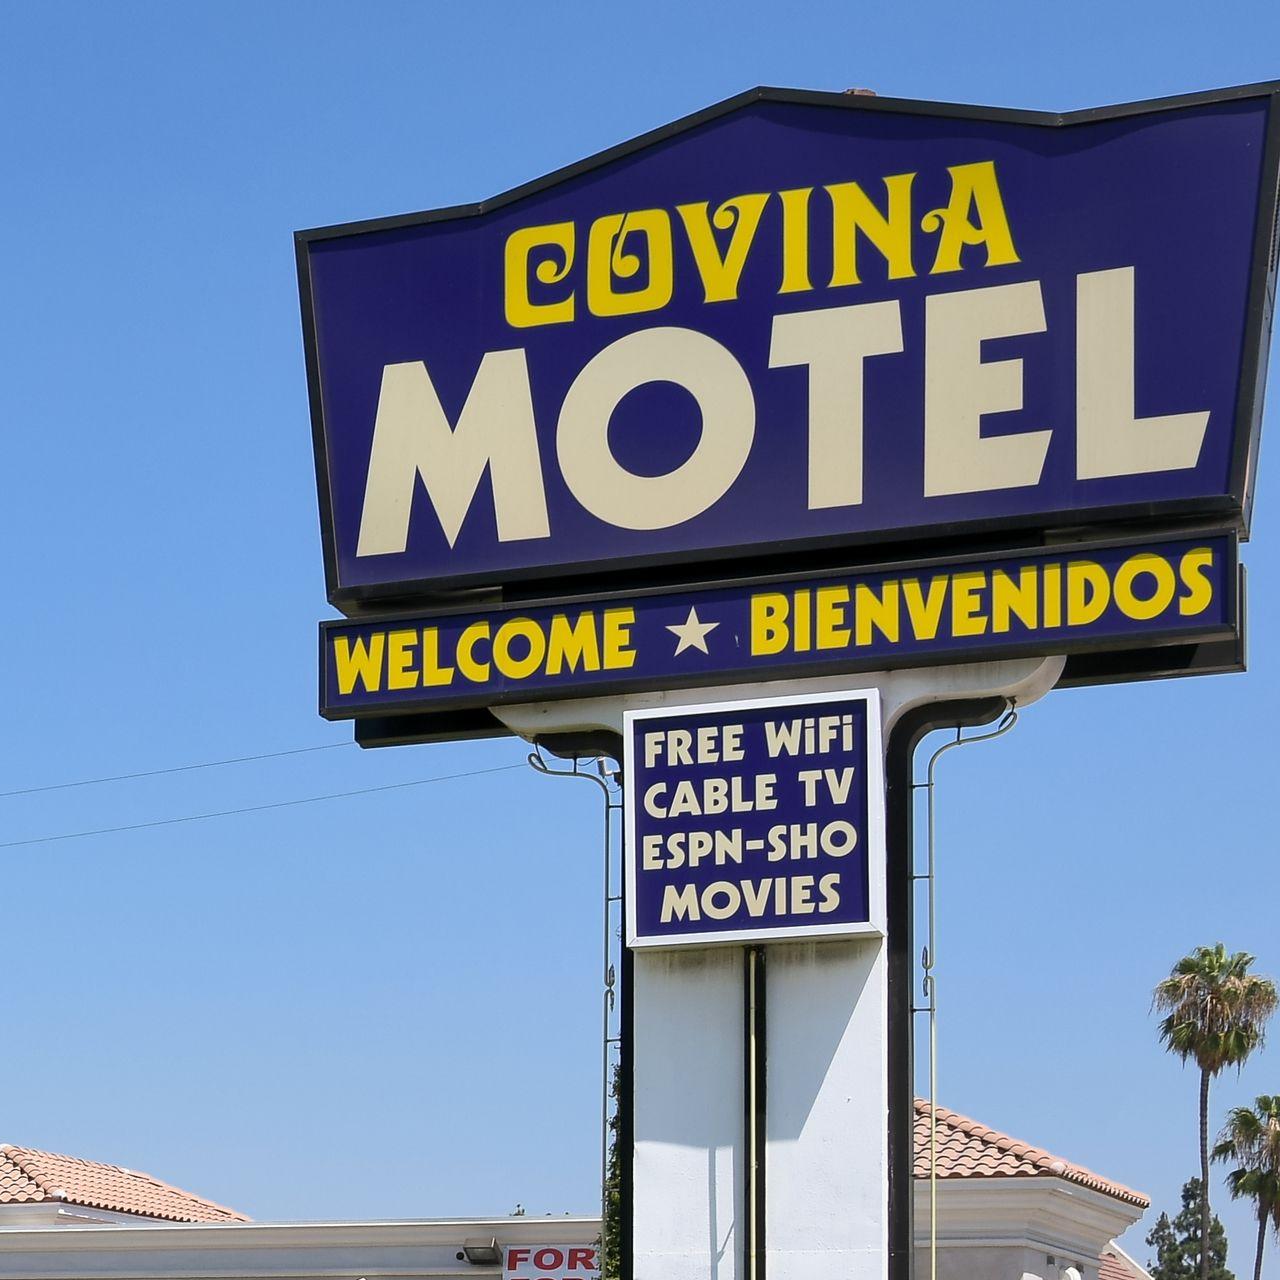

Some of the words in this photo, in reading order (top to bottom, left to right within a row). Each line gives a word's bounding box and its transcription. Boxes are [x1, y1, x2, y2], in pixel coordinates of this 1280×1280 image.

[504, 161, 1020, 328] COVINA
[356, 266, 1210, 557] MOTEL
[333, 607, 637, 695] WELCOME
[750, 547, 1214, 657] BIENVENIDOS
[643, 720, 746, 769] FREE
[765, 714, 854, 758] WiFi
[643, 773, 778, 819] CABLE
[798, 767, 855, 807] TV
[642, 820, 858, 871] ESPN-SHO
[659, 873, 841, 924] MOVIES
[507, 1248, 596, 1271] FOR
